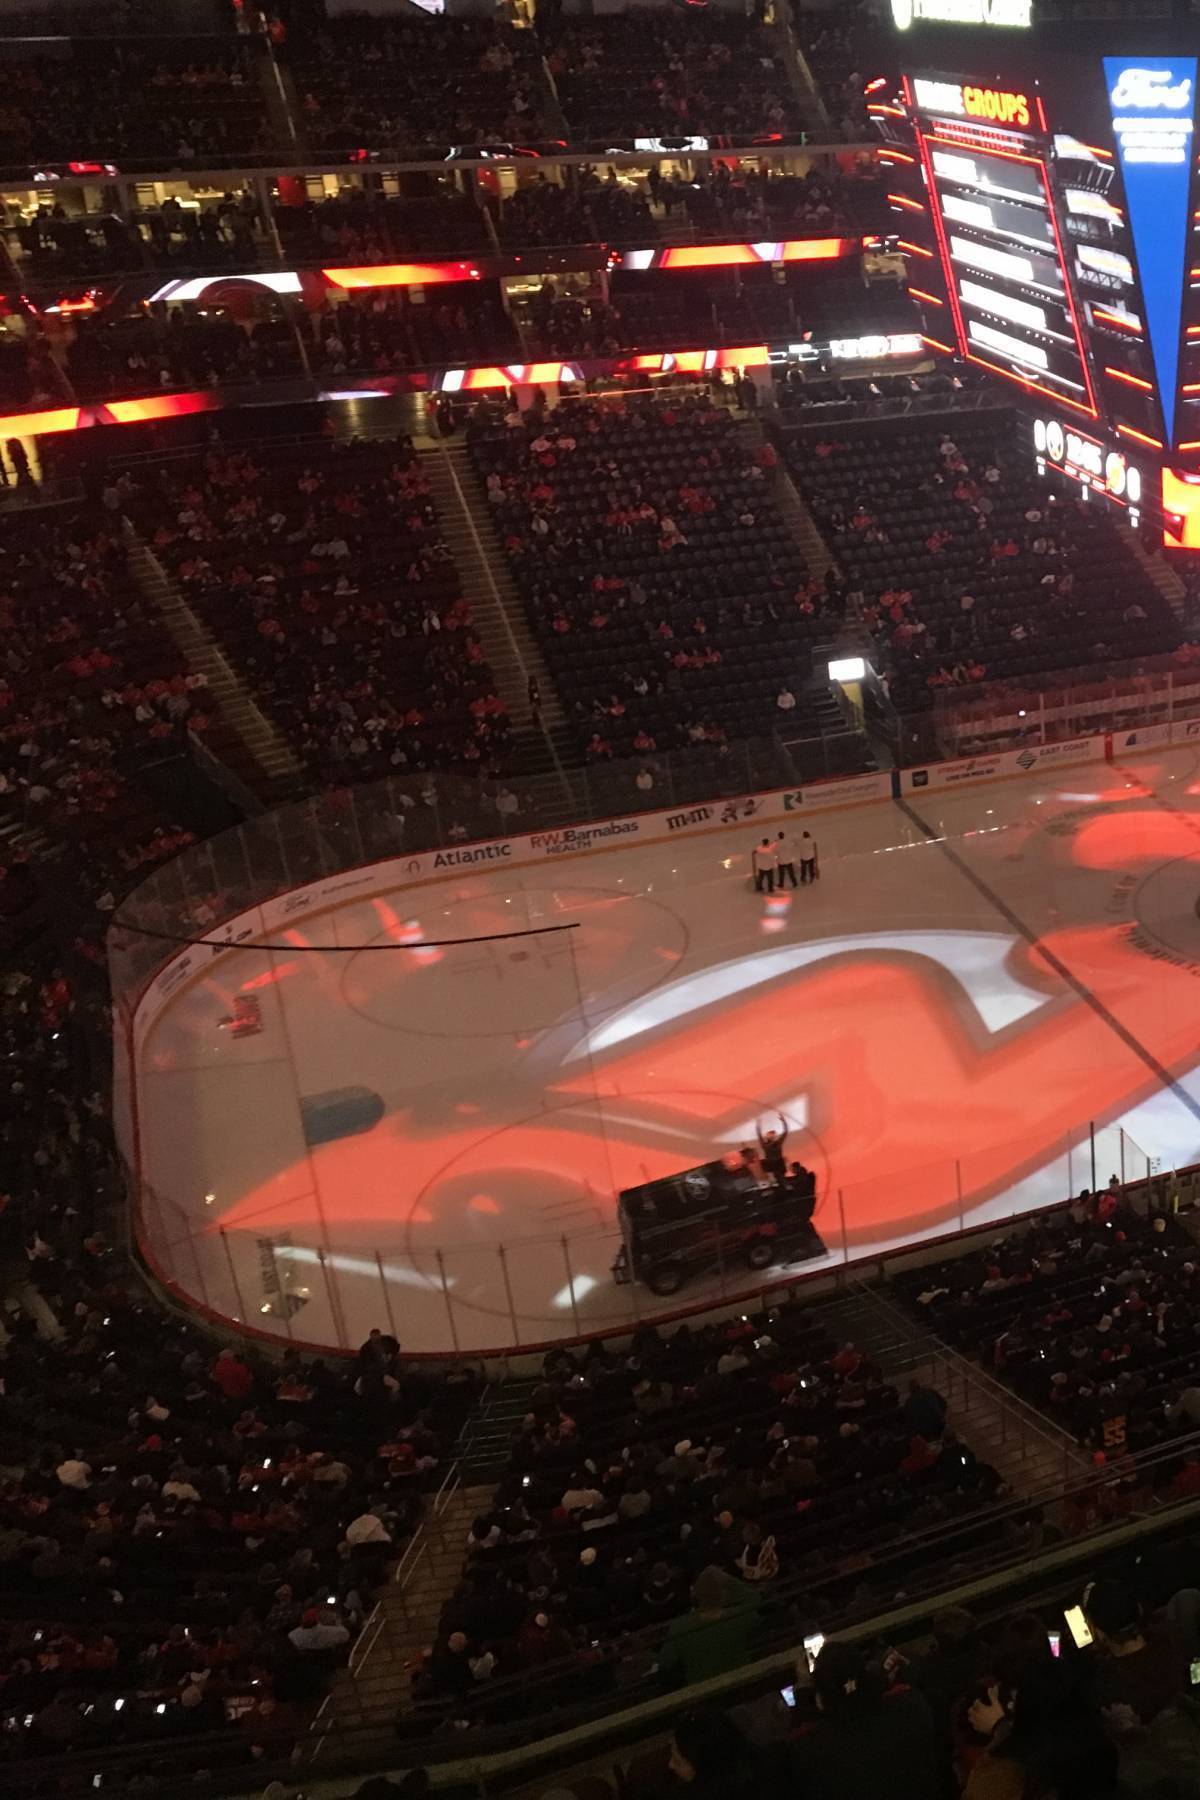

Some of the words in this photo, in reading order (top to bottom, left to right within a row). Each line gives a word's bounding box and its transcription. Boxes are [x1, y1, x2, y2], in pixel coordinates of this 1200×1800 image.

[964, 87, 1030, 126] GROUPS
[530, 821, 639, 849] RWJBarnabas
[546, 841, 592, 855] HEALTH
[433, 843, 512, 869] Atlantic
